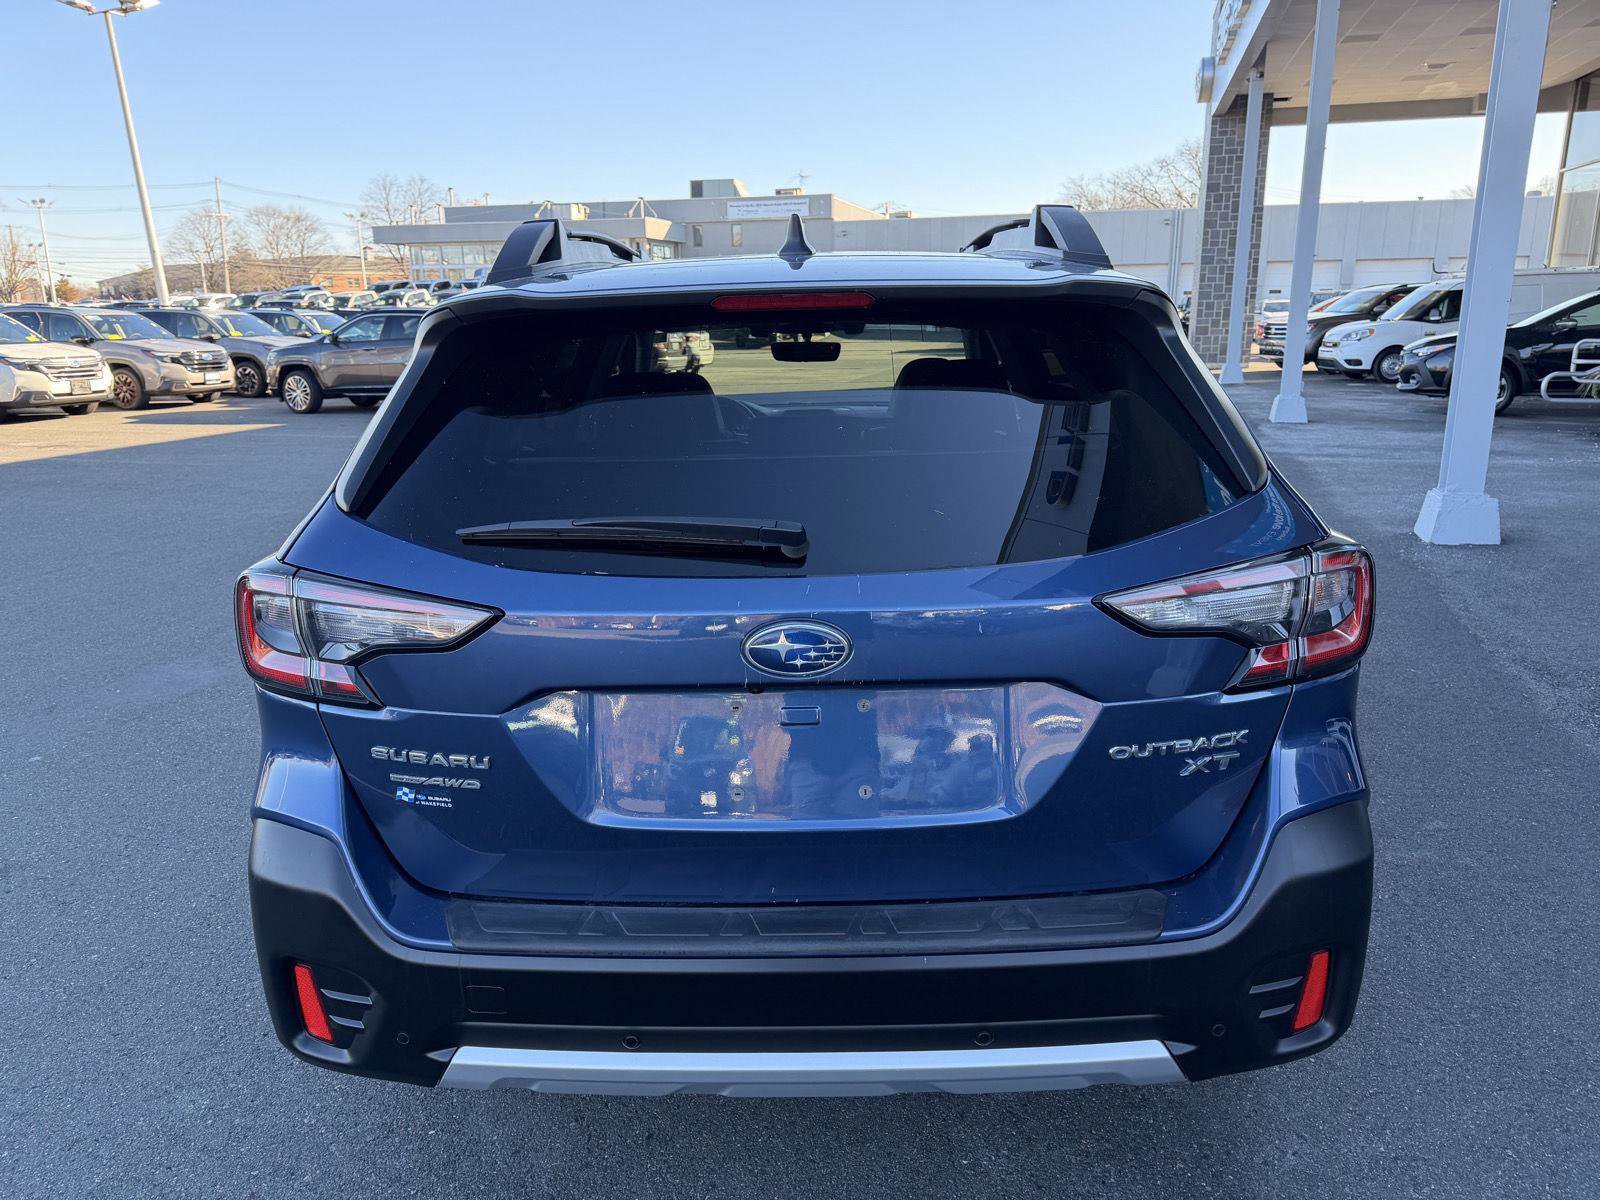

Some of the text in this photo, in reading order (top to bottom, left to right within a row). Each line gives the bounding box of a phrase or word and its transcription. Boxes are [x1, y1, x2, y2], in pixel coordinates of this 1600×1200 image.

[370, 745, 491, 770] SUBARU
[1108, 729, 1250, 760] OUTBACK
[1179, 750, 1241, 777] XT
[422, 776, 482, 790] AWD
